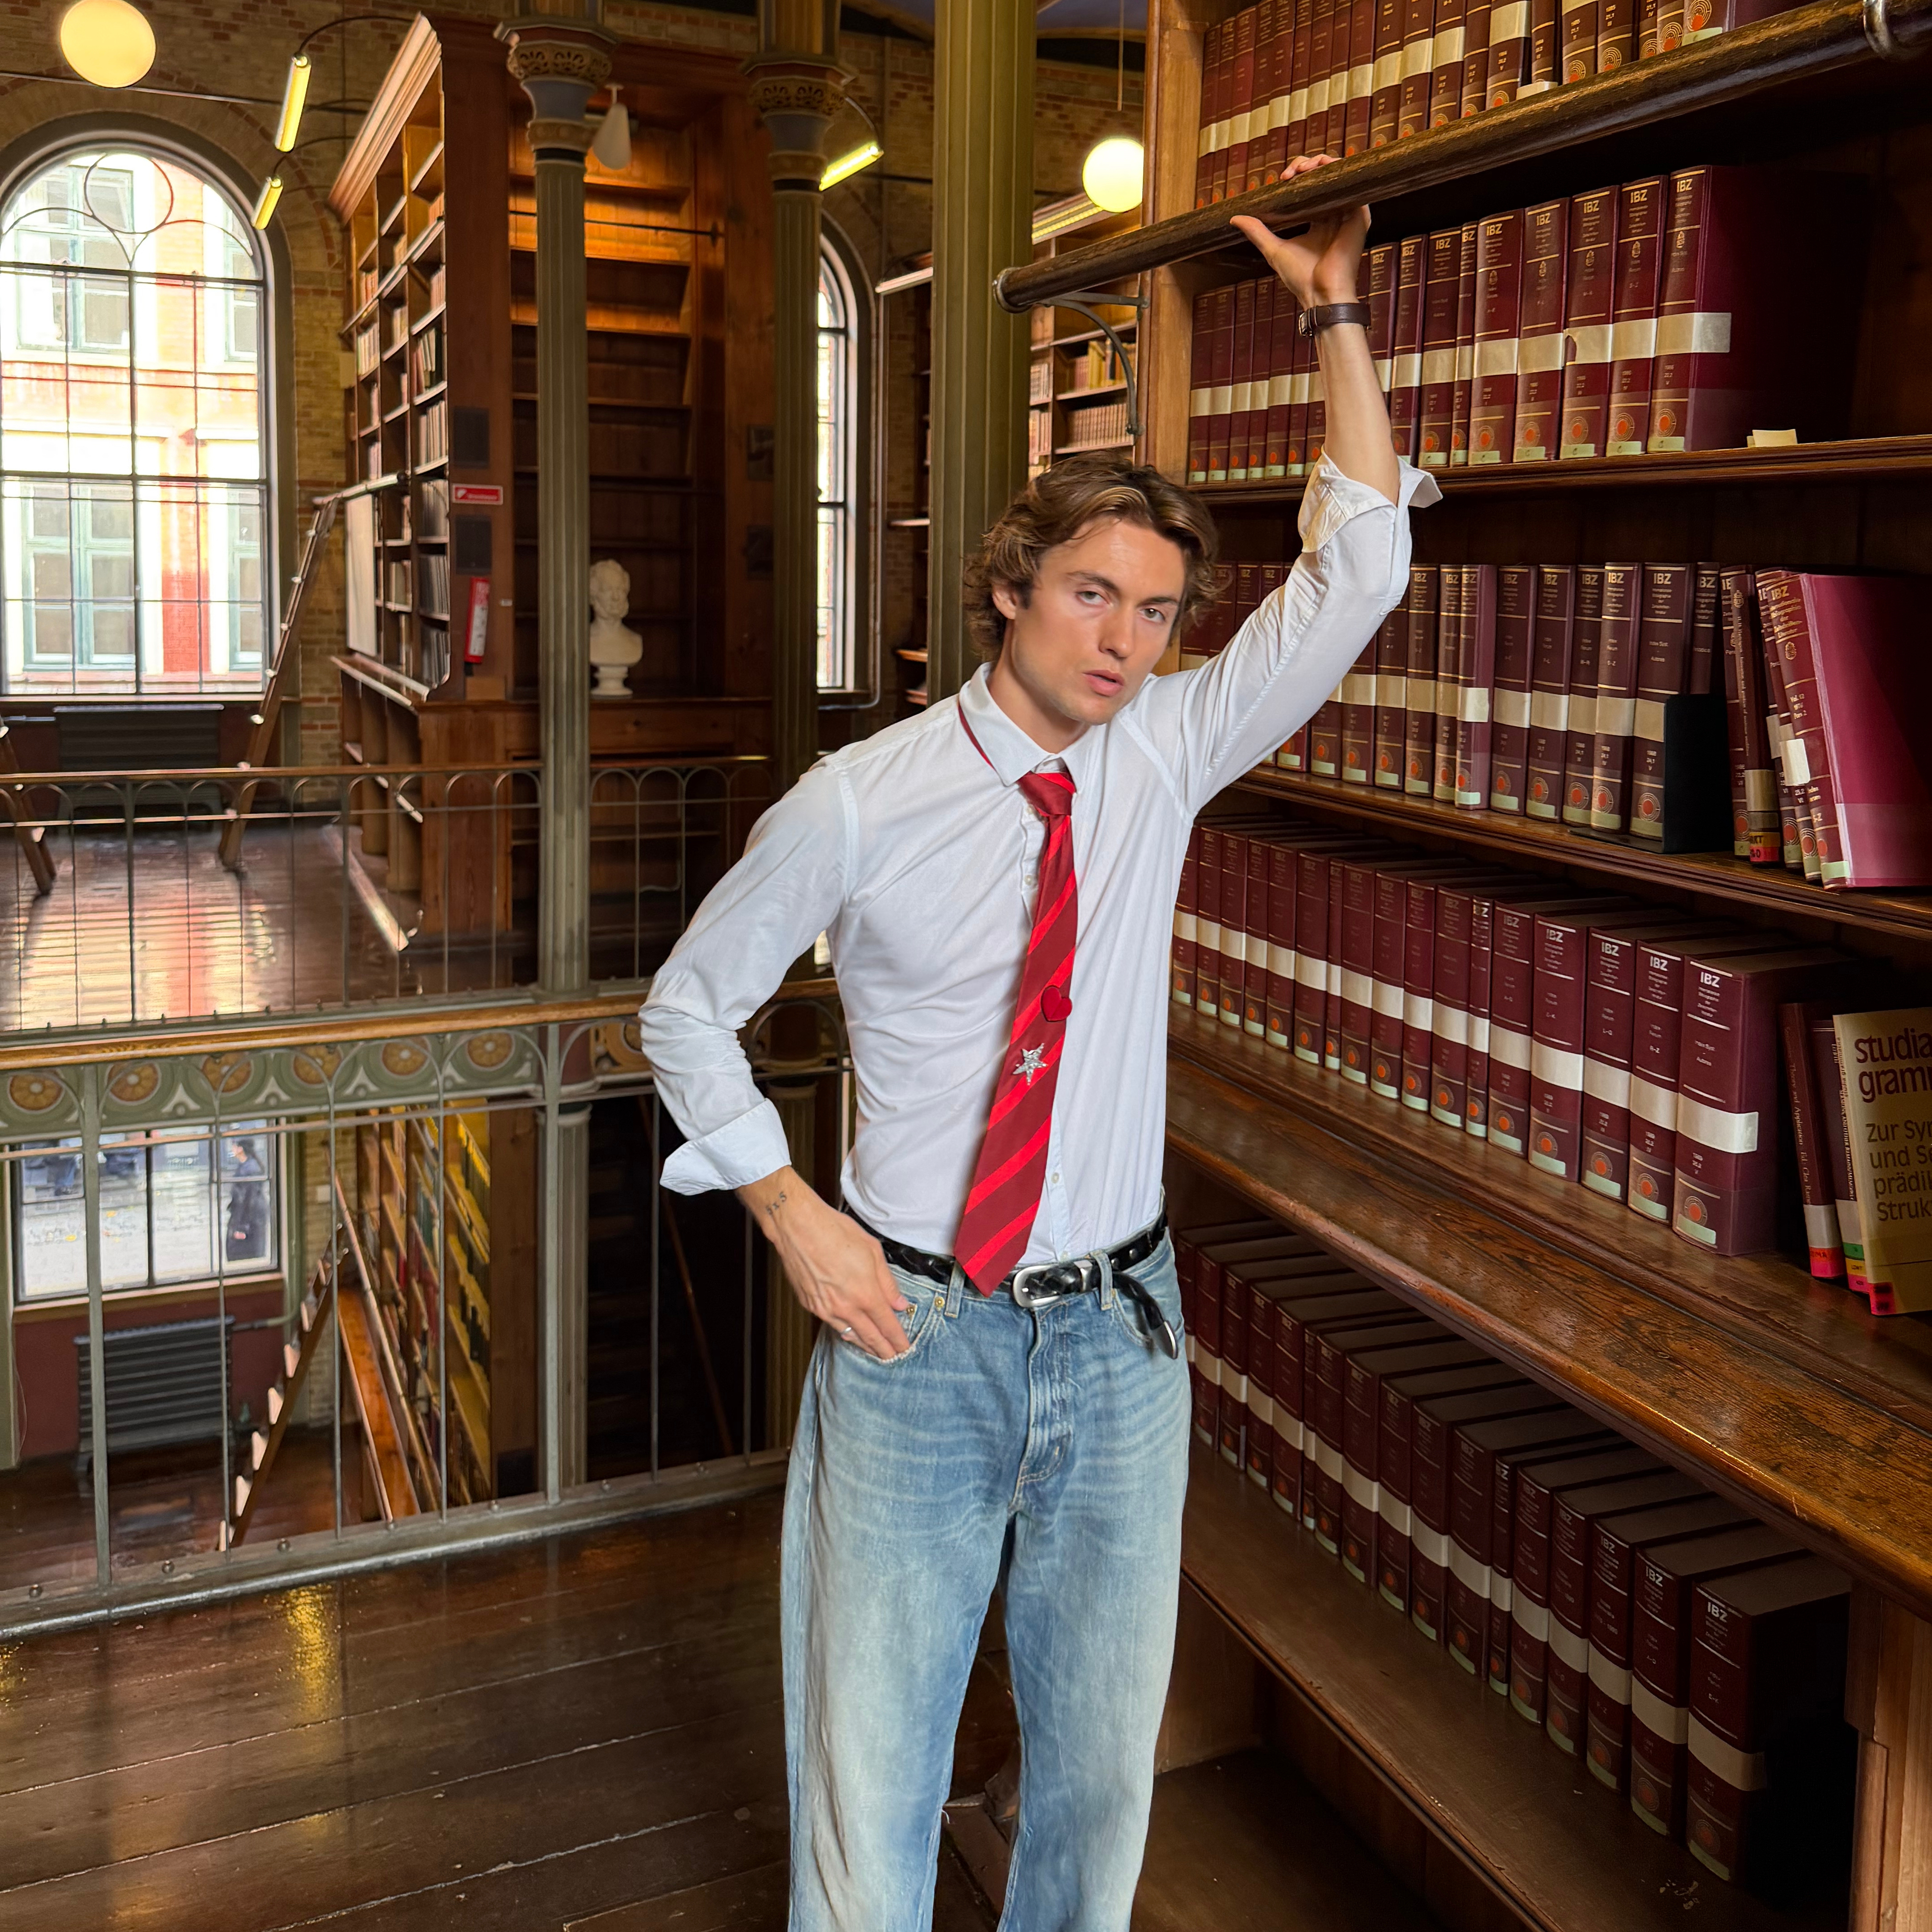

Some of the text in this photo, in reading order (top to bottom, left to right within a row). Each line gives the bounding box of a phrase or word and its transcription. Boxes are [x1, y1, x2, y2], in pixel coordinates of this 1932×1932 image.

[1676, 178, 1693, 193] IBZ
[1630, 190, 1648, 203] IBZ
[1583, 200, 1599, 213] IBZ
[1536, 213, 1551, 226] IBZ
[1486, 223, 1502, 236] IBZ
[1436, 238, 1450, 250] IBZ
[1402, 245, 1415, 257] IBZ
[1414, 573, 1427, 582] IBZ
[1446, 574, 1459, 583] IBZ
[1504, 574, 1517, 584] IBZ
[1544, 574, 1557, 585] IBZ
[1582, 574, 1599, 585] IBZ
[1608, 572, 1624, 583] IBZ
[1654, 573, 1672, 584] IBZ
[1771, 585, 1790, 600] IBZ
[1504, 914, 1519, 928] IBZ
[1546, 928, 1563, 942] IBZ
[1601, 941, 1619, 957] IBZ
[1650, 956, 1668, 971] IBZ
[1700, 972, 1720, 988] IBZ
[1854, 1028, 1932, 1064] studia
[1794, 1107, 1804, 1145] Application
[1869, 1147, 1910, 1168] und
[1601, 1536, 1615, 1553] IBZ
[1646, 1566, 1663, 1587] IBZ
[1707, 1602, 1727, 1623] IBZ
